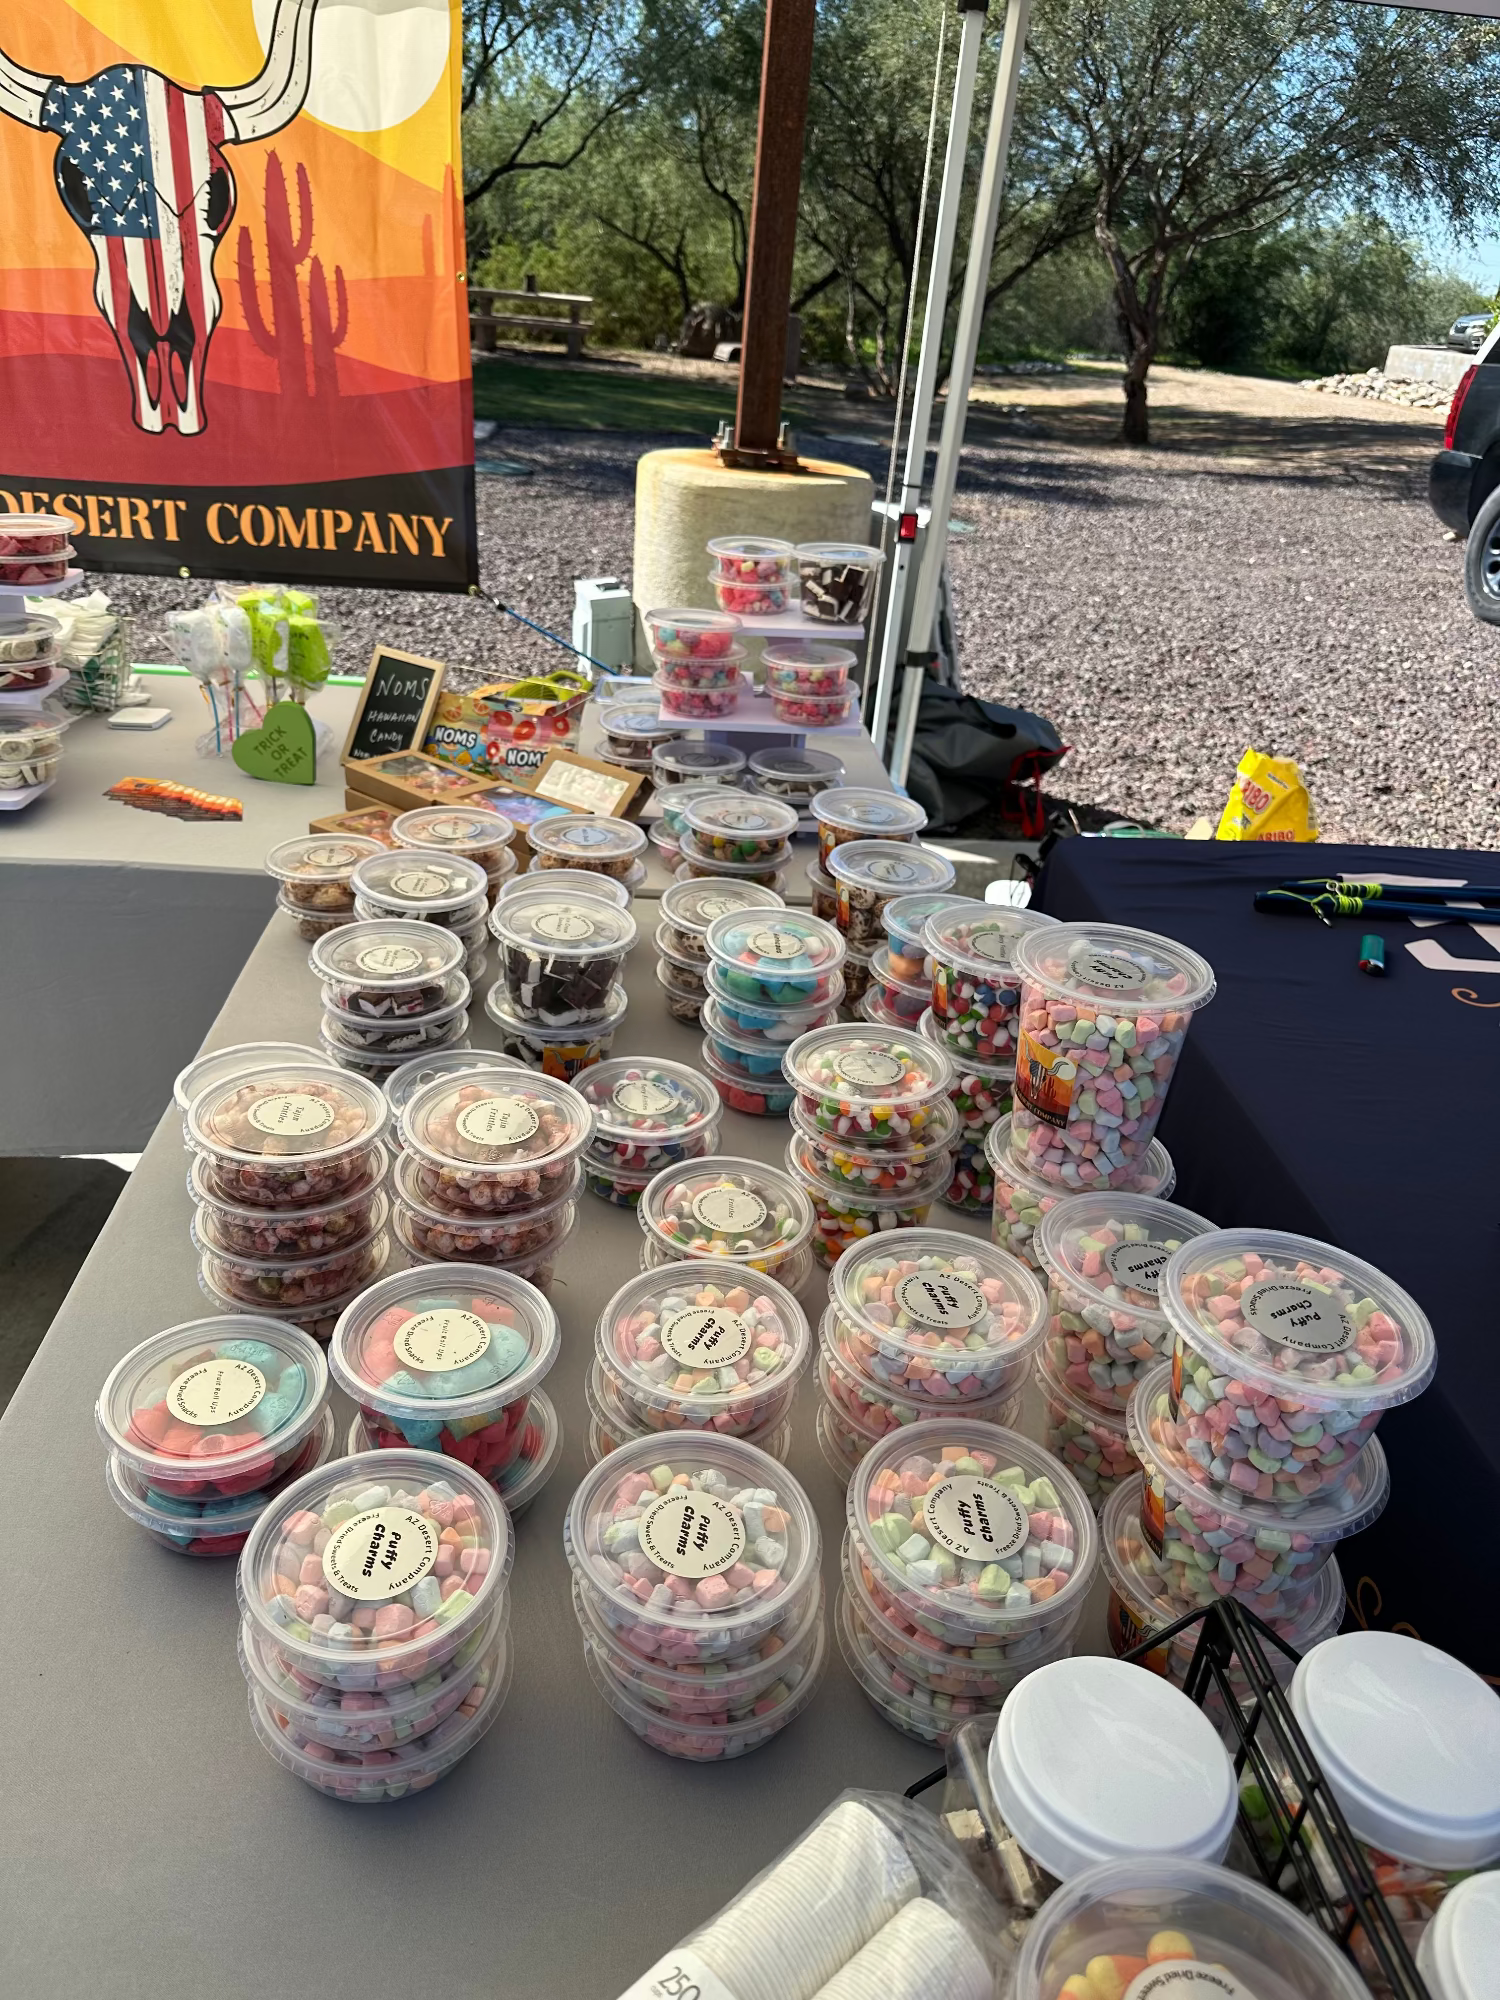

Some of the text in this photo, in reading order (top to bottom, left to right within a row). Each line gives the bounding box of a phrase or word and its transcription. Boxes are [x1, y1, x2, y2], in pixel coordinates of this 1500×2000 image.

[206, 503, 454, 557] COMPANY
[376, 674, 429, 700] NOMS
[253, 725, 287, 755] TRICK
[435, 726, 477, 747] NOMS
[271, 744, 289, 760] OR
[274, 746, 308, 778] TREAT
[1257, 829, 1295, 842] ARIBO
[525, 1108, 536, 1125] Desert
[509, 1125, 536, 1141] Company
[1128, 1256, 1167, 1272] Charms
[1145, 1269, 1160, 1279] ffy
[922, 1282, 949, 1315] Charms
[937, 1285, 959, 1309] Puffy
[954, 1277, 978, 1294] Desert
[967, 1295, 982, 1320] Company
[1136, 1284, 1158, 1292] pany
[1250, 1285, 1311, 1316] Freeze Dried Snacks
[1270, 1300, 1312, 1319] Charms
[677, 1312, 692, 1322] Dried
[926, 1316, 948, 1325] Treats
[1290, 1312, 1321, 1327] Puffy
[404, 1316, 434, 1364] Freeze Dried Snacks
[472, 1320, 487, 1339] Desert
[688, 1318, 715, 1350] Charms
[703, 1326, 725, 1350] Puffy
[1282, 1314, 1351, 1349] AZ Desert Company
[436, 1349, 444, 1360] Ups
[454, 1341, 486, 1365] Company
[704, 1350, 741, 1364] Company
[216, 1371, 224, 1386] Fruit
[246, 1369, 261, 1389] Desert
[177, 1368, 207, 1418] Freeze Dried Snacks
[228, 1390, 260, 1417] Company
[210, 1401, 218, 1413] Ups
[977, 1481, 1000, 1494] Treats
[664, 1495, 688, 1505] Freeze
[1007, 1498, 1021, 1521] Sweets
[352, 1513, 380, 1526] Freeze
[649, 1504, 664, 1520] Dried
[928, 1484, 969, 1553] AZ Desert Company
[958, 1500, 975, 1535] Puffy
[973, 1493, 994, 1542] Charms
[337, 1526, 354, 1544] Dried
[646, 1520, 654, 1545] Sweets
[677, 1506, 695, 1556] Charms
[693, 1515, 710, 1551] Puffy
[703, 1501, 740, 1571] AZ Desert Company
[1013, 1521, 1022, 1540] Dried
[331, 1545, 340, 1570] Sweets
[362, 1524, 385, 1577] Charms
[381, 1532, 401, 1570] Puffy
[389, 1516, 432, 1590] AZ Desert Company
[996, 1539, 1016, 1554] Freeze
[654, 1551, 675, 1569] Treats
[337, 1575, 358, 1592] Treats
[657, 1966, 701, 2000] 250
[1136, 1970, 1235, 2000] Freeze Dried Sweet
